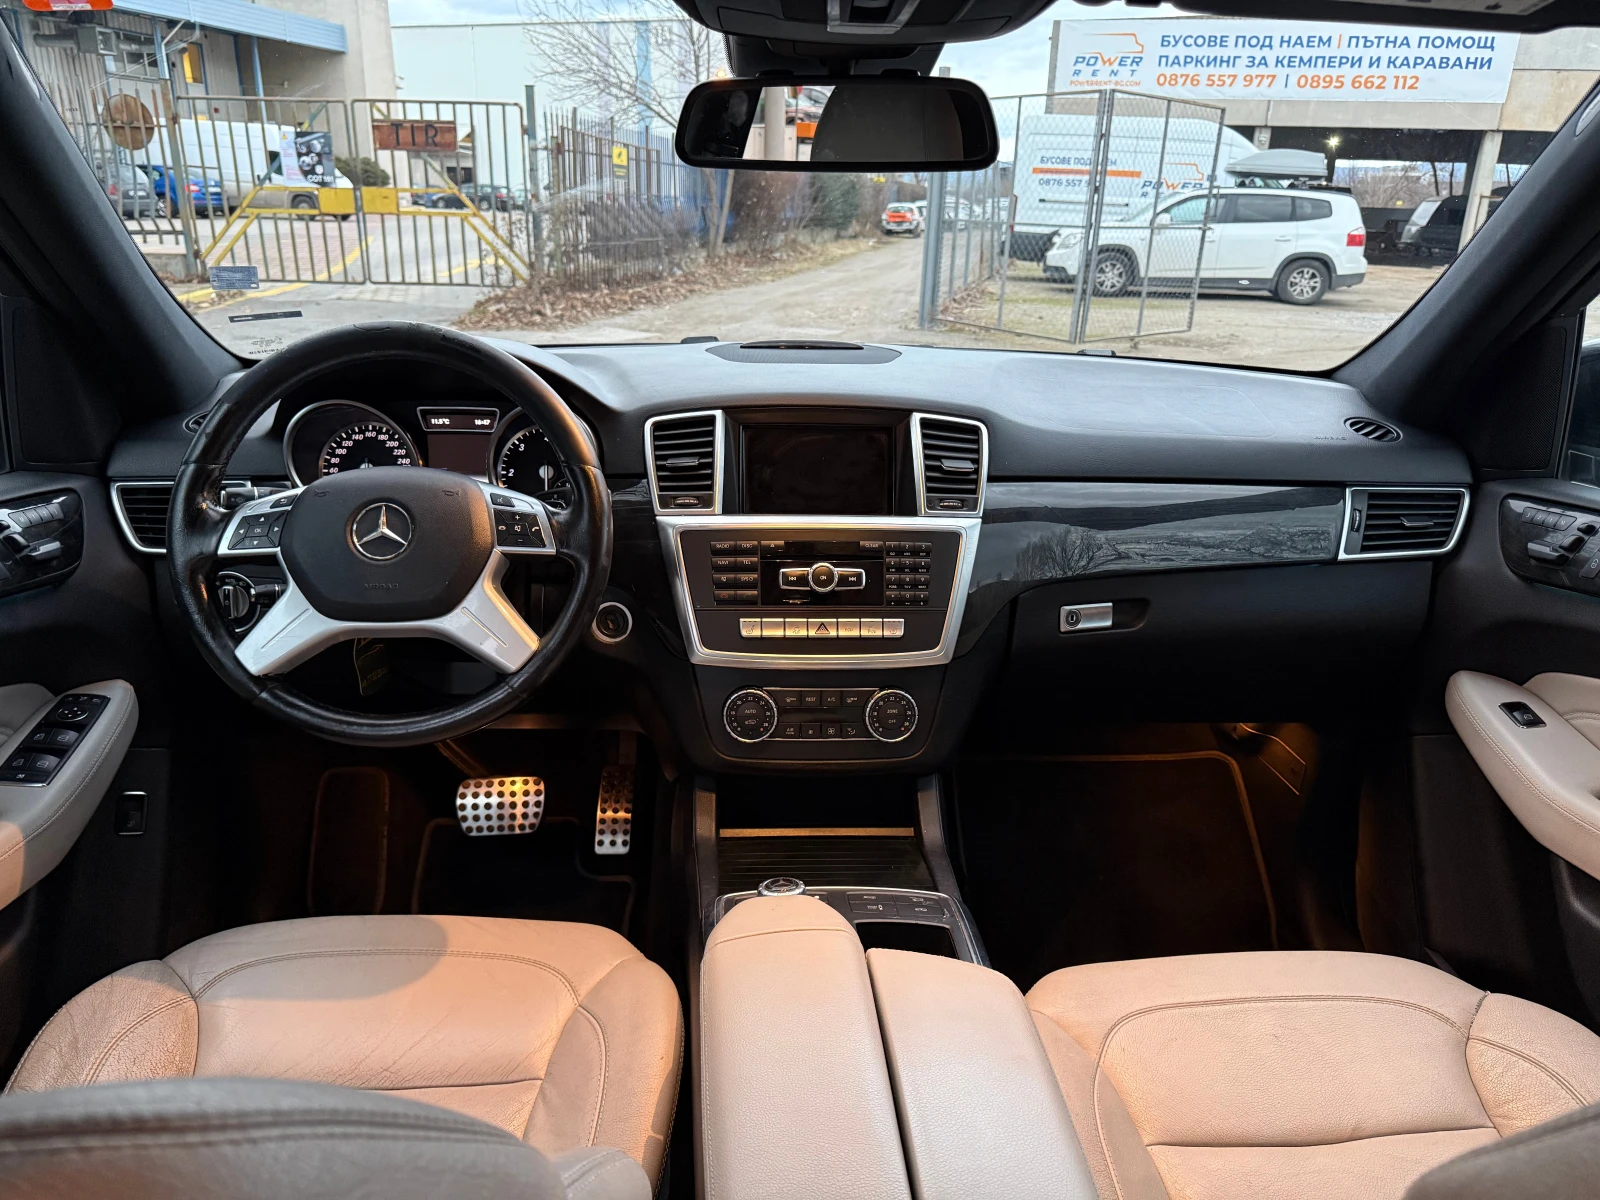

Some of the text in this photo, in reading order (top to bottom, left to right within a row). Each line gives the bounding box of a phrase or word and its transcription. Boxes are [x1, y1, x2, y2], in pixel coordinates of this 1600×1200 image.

[1160, 35, 1496, 51] БУСОВЕ ПОД НАЕМ ПЪТНА ПОМОЩ
[1073, 54, 1144, 67] POWER
[1158, 55, 1493, 70] ПАРКИНГ ЗА КЕМПЕРИ И КАРАВАНИ
[1072, 69, 1138, 77] RENT
[1156, 73, 1420, 90] 0876 557 977 0895 662 112
[390, 123, 439, 148] TIR
[1040, 156, 1072, 166] БУСОВЕ
[1038, 178, 1063, 187] 0876
[1064, 178, 1082, 188] 557
